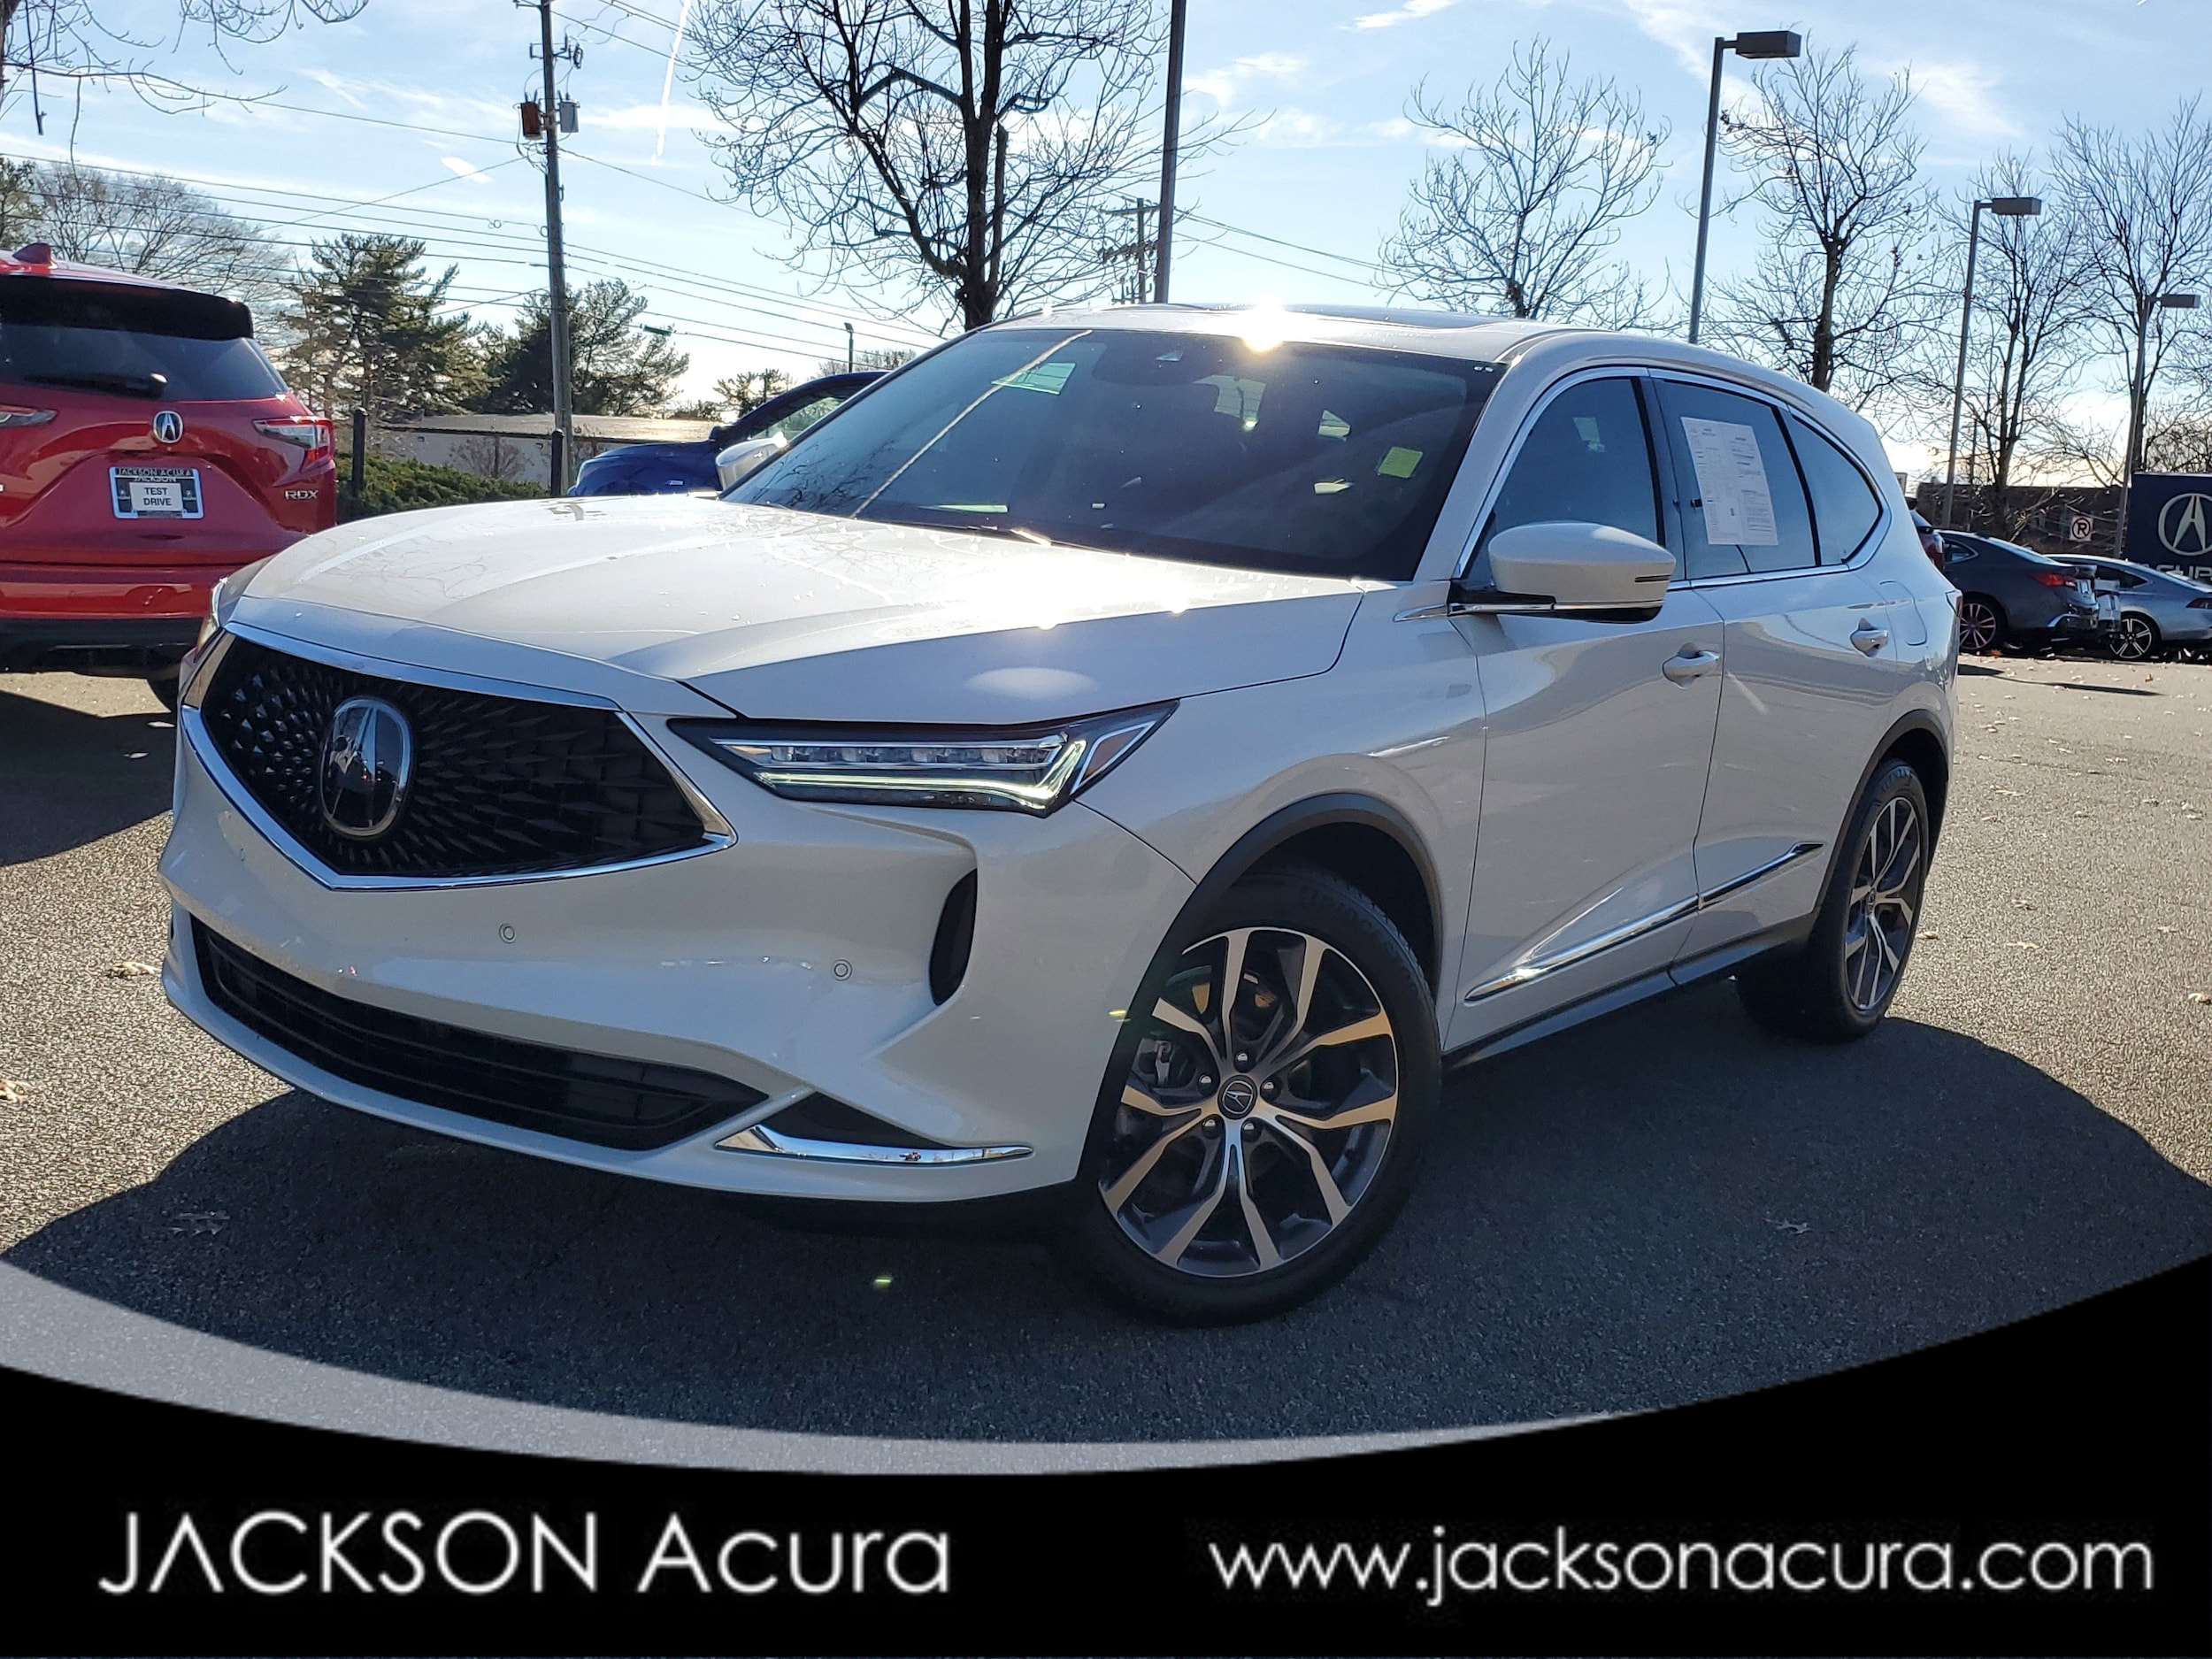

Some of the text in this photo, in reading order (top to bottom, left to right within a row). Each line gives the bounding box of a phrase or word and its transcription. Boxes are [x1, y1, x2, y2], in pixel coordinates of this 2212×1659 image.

[118, 467, 191, 477] JACKSON ACURA
[144, 487, 168, 495] TEST
[285, 489, 319, 500] RDX
[143, 497, 173, 506] DRIVE
